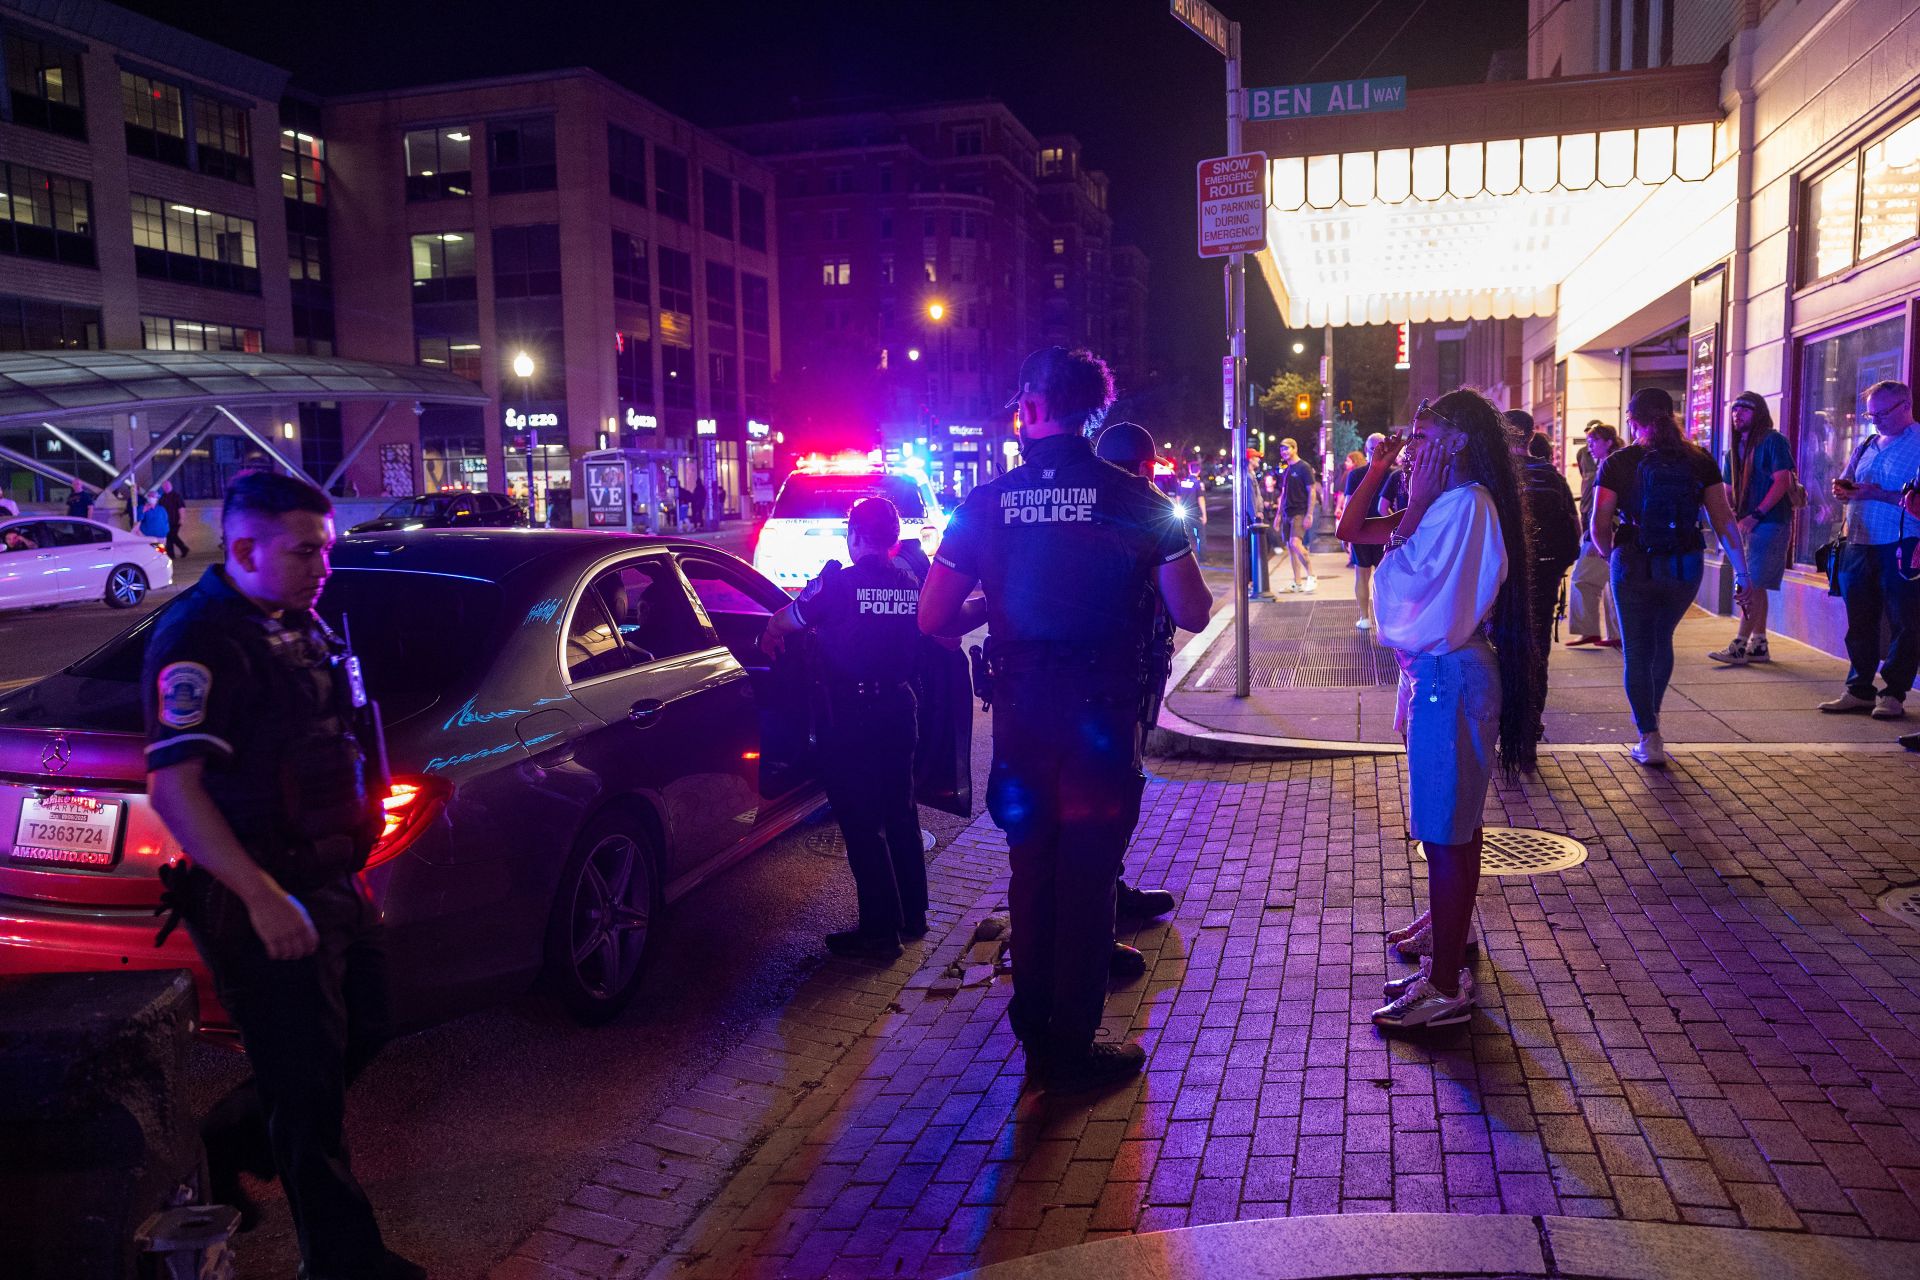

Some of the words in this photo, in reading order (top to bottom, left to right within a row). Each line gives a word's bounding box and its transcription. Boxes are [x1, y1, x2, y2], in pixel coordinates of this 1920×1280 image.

[1253, 87, 1311, 118] BEN
[1327, 81, 1370, 112] ALI
[1373, 86, 1401, 103] WAY
[1213, 158, 1250, 175] SNOW
[1204, 170, 1258, 186] EMERGENCY
[1209, 181, 1255, 198] ROUTE
[1204, 204, 1218, 216] NO
[1221, 198, 1260, 213] PARKING
[1215, 213, 1250, 228] DURING
[1204, 224, 1260, 241] EMERGENCY
[1000, 488, 1097, 508] METROPOLITAN
[1004, 504, 1093, 524] POLICE
[856, 588, 919, 601] METROPOLITAN
[859, 601, 917, 614] POLICE
[47, 802, 105, 815] MARYLAD
[29, 823, 103, 844] T2363724
[11, 846, 109, 864] AMKOAUTO.COM
